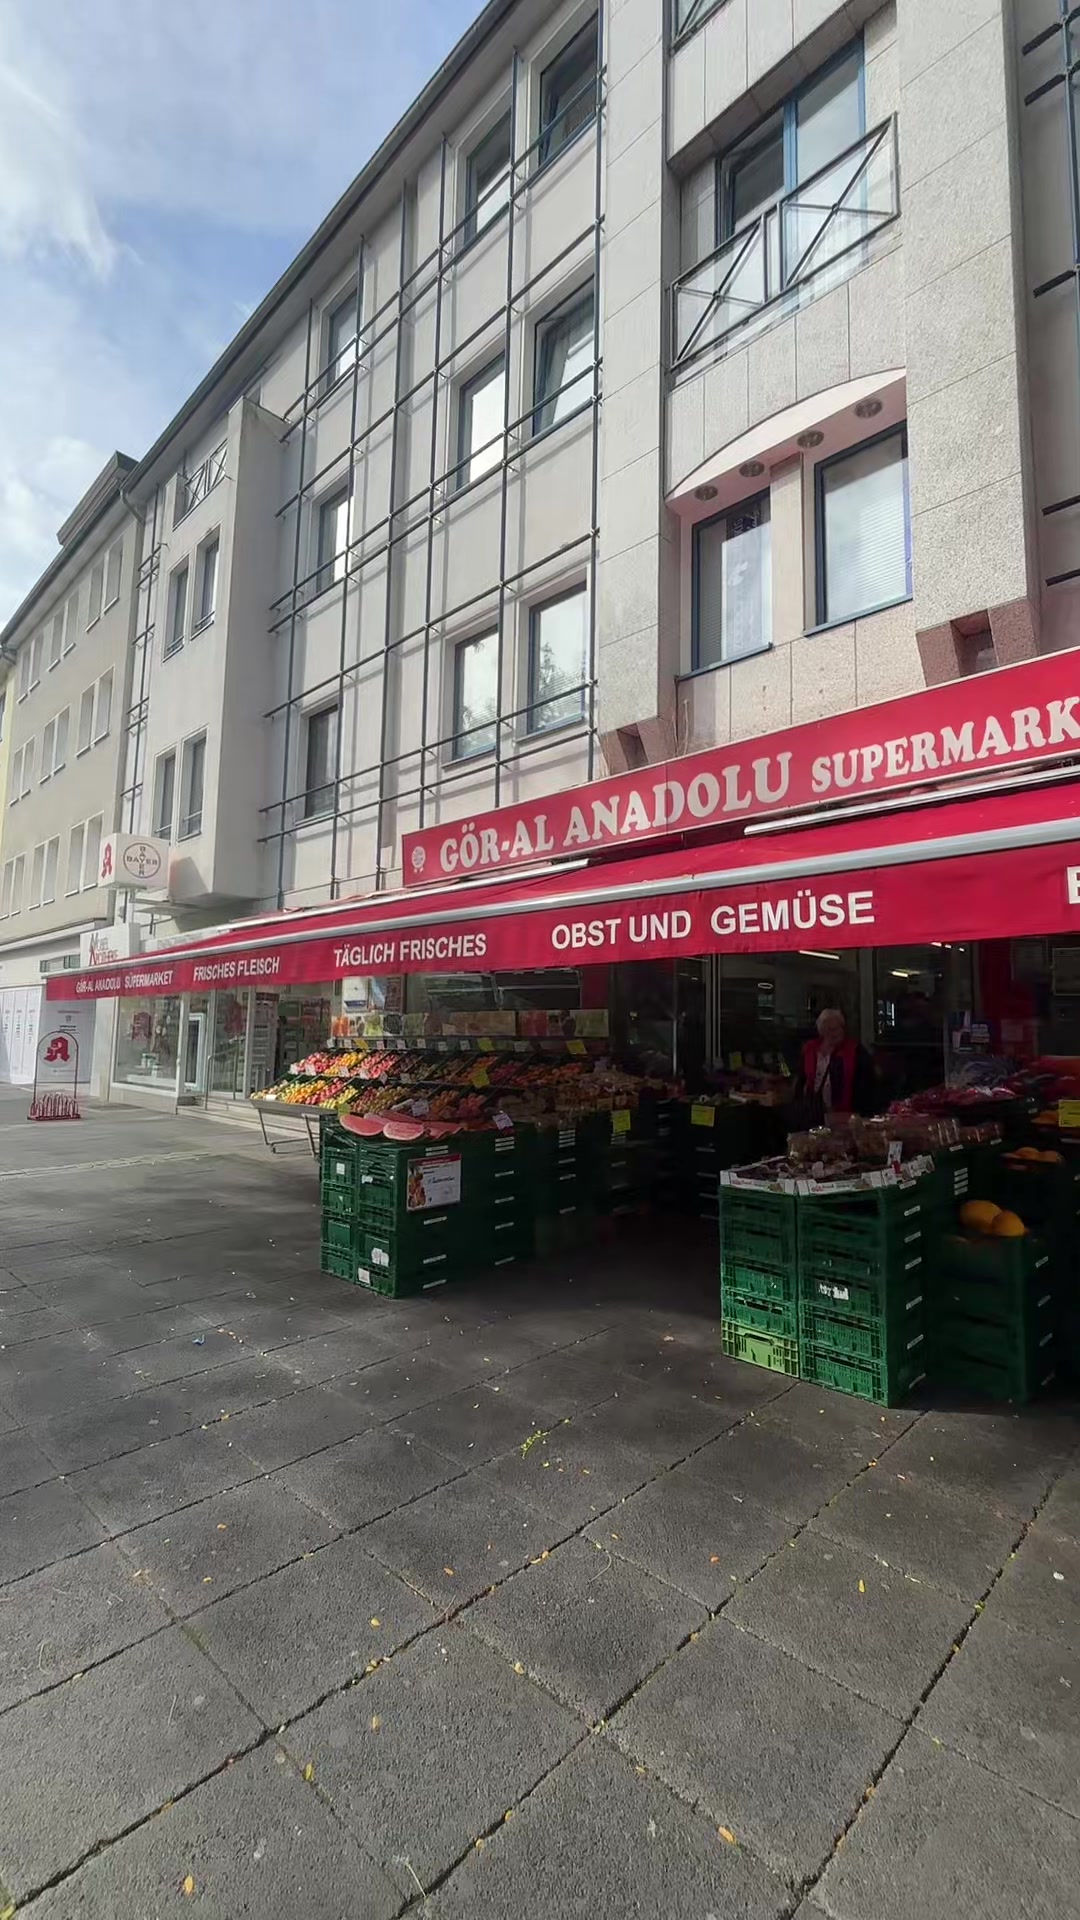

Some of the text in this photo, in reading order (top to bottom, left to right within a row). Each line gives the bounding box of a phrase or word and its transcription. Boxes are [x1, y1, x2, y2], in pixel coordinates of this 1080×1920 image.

[440, 814, 554, 873] GÖR-AL
[563, 751, 793, 847] ANADOLU
[551, 889, 876, 950] OBST UND GEMÜSE
[193, 956, 280, 982] FRISCHES FLEISCH
[334, 932, 487, 968] TÄGLICH FRISCHES
